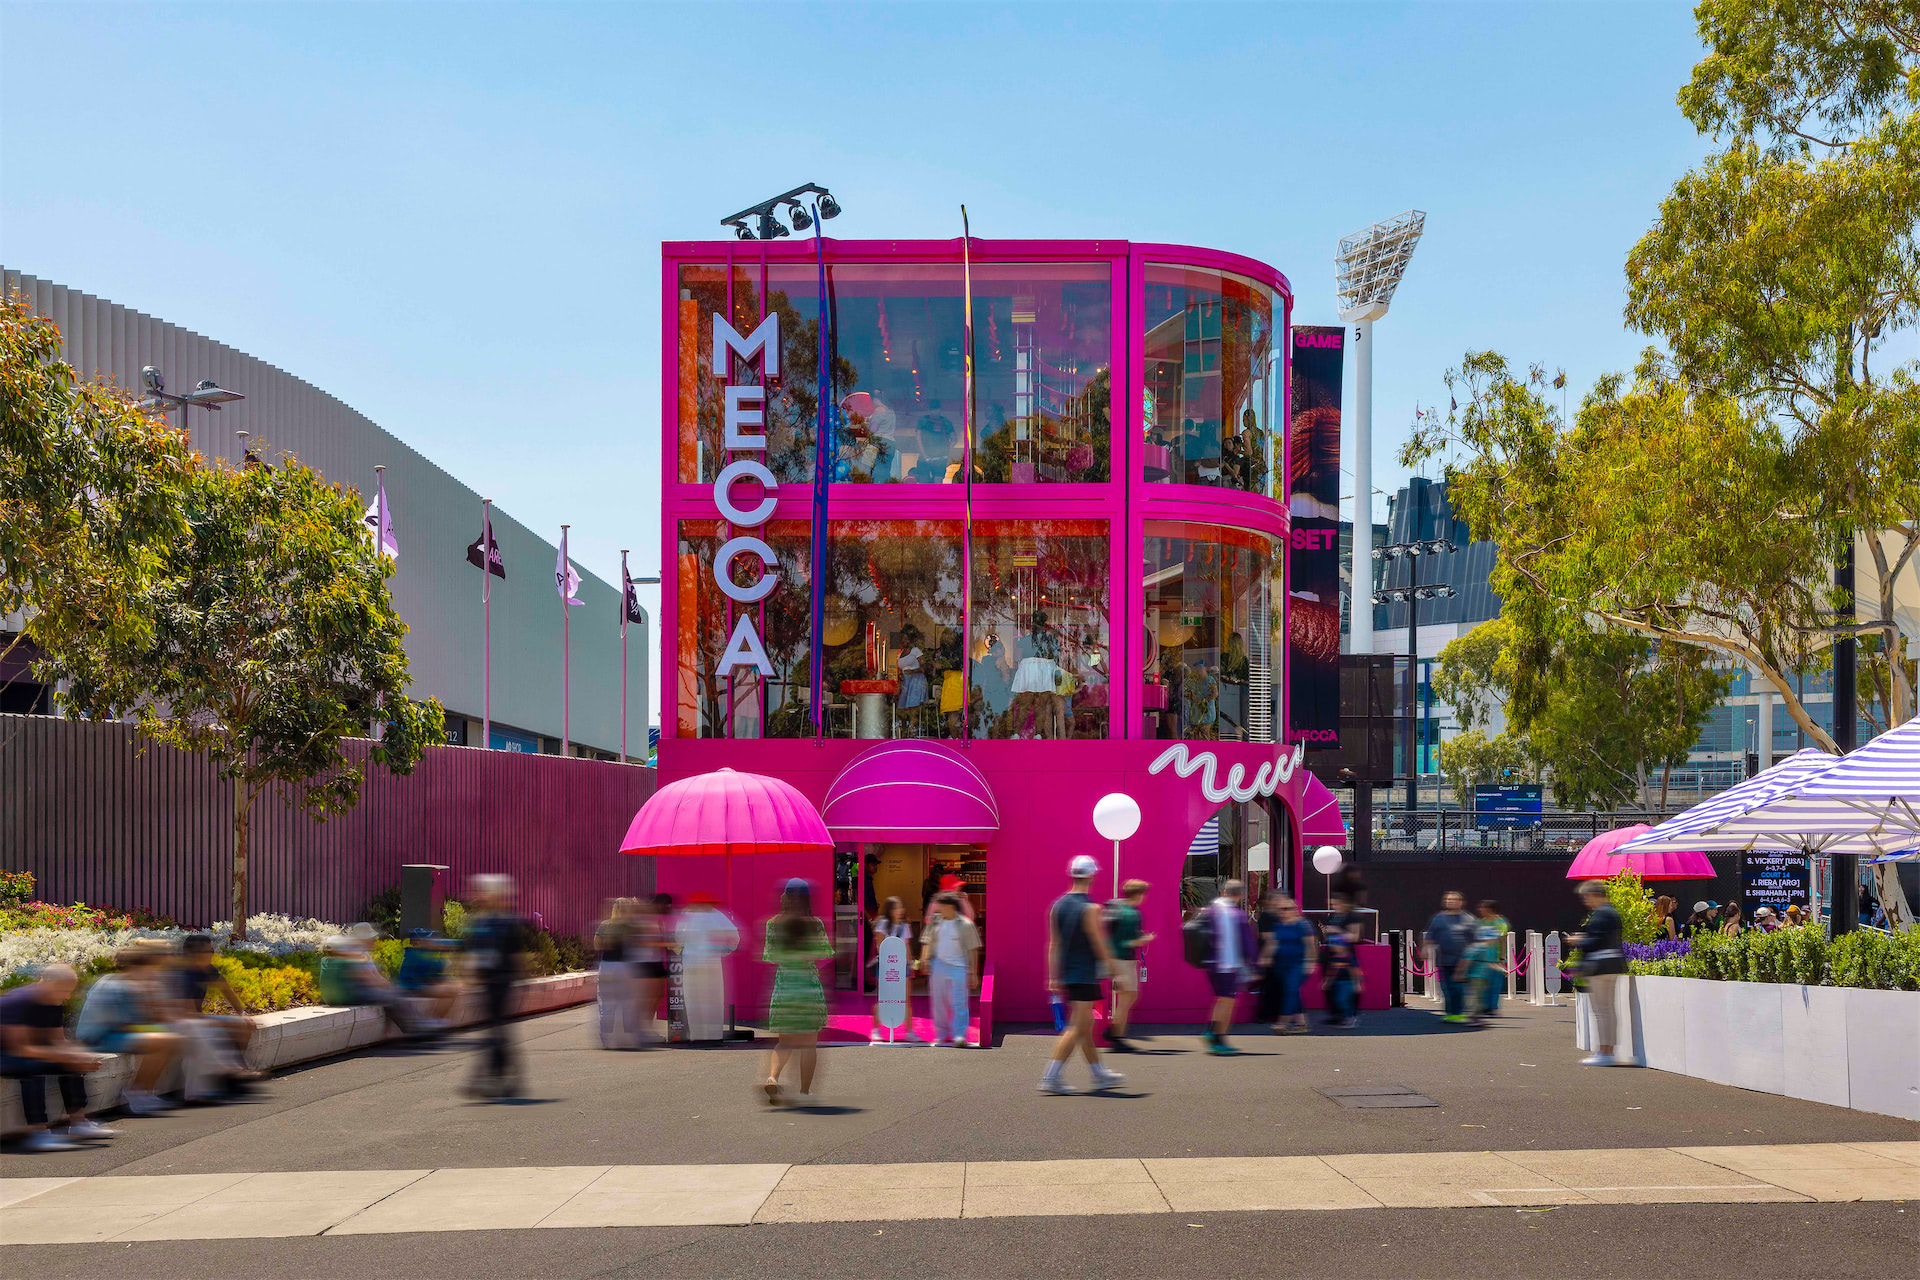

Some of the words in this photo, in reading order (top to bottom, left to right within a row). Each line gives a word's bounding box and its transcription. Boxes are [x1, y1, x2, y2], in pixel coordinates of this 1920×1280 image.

[1295, 333, 1342, 348] GAME
[713, 311, 779, 676] MECCA
[1291, 528, 1336, 550] SET
[1290, 729, 1338, 741] MECCA
[1747, 857, 1754, 865] S.
[1754, 857, 1784, 865] VICKERY
[1785, 857, 1804, 866] [USA]
[1779, 879, 1801, 888] [ARG]
[1788, 890, 1805, 898] [JPN]
[669, 996, 684, 1004] 50+
